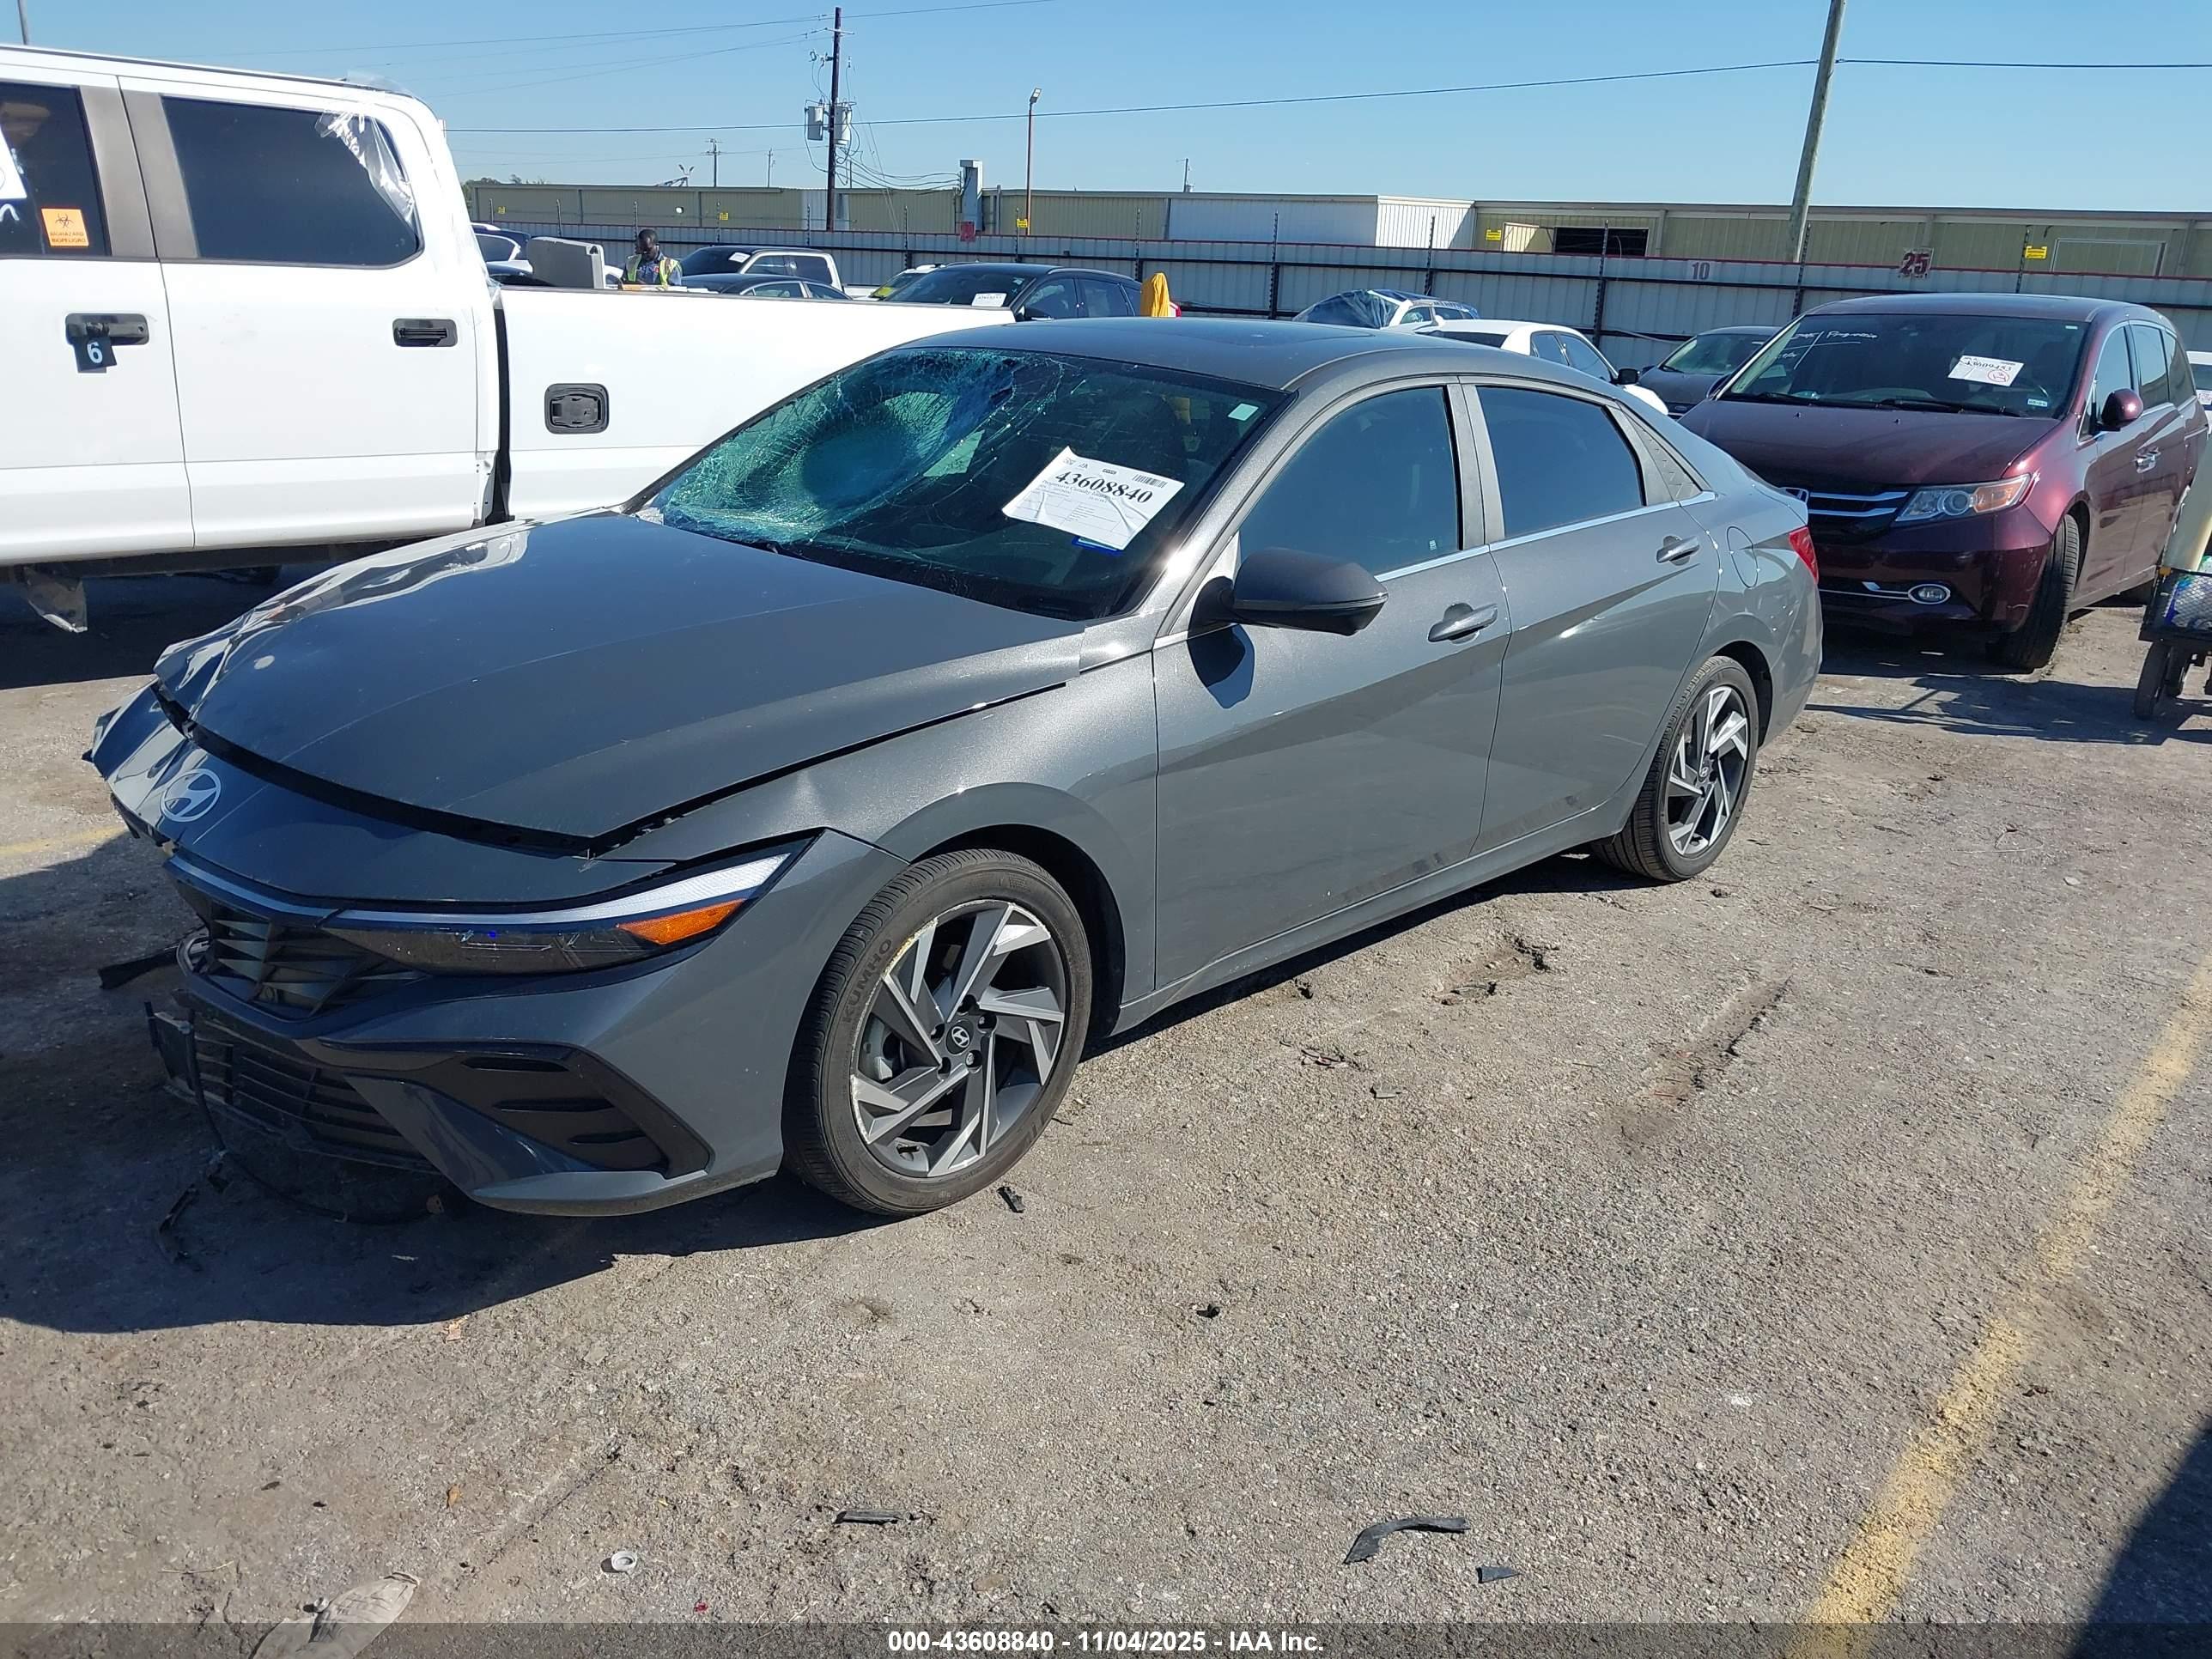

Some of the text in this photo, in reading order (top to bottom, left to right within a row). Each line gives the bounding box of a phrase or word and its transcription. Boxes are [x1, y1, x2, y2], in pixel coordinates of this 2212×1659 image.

[1692, 262, 1711, 280] 10
[1899, 252, 1929, 275] 25
[86, 341, 104, 365] 6
[1054, 471, 1153, 503] 43608840
[842, 939, 892, 1024] KUMHO
